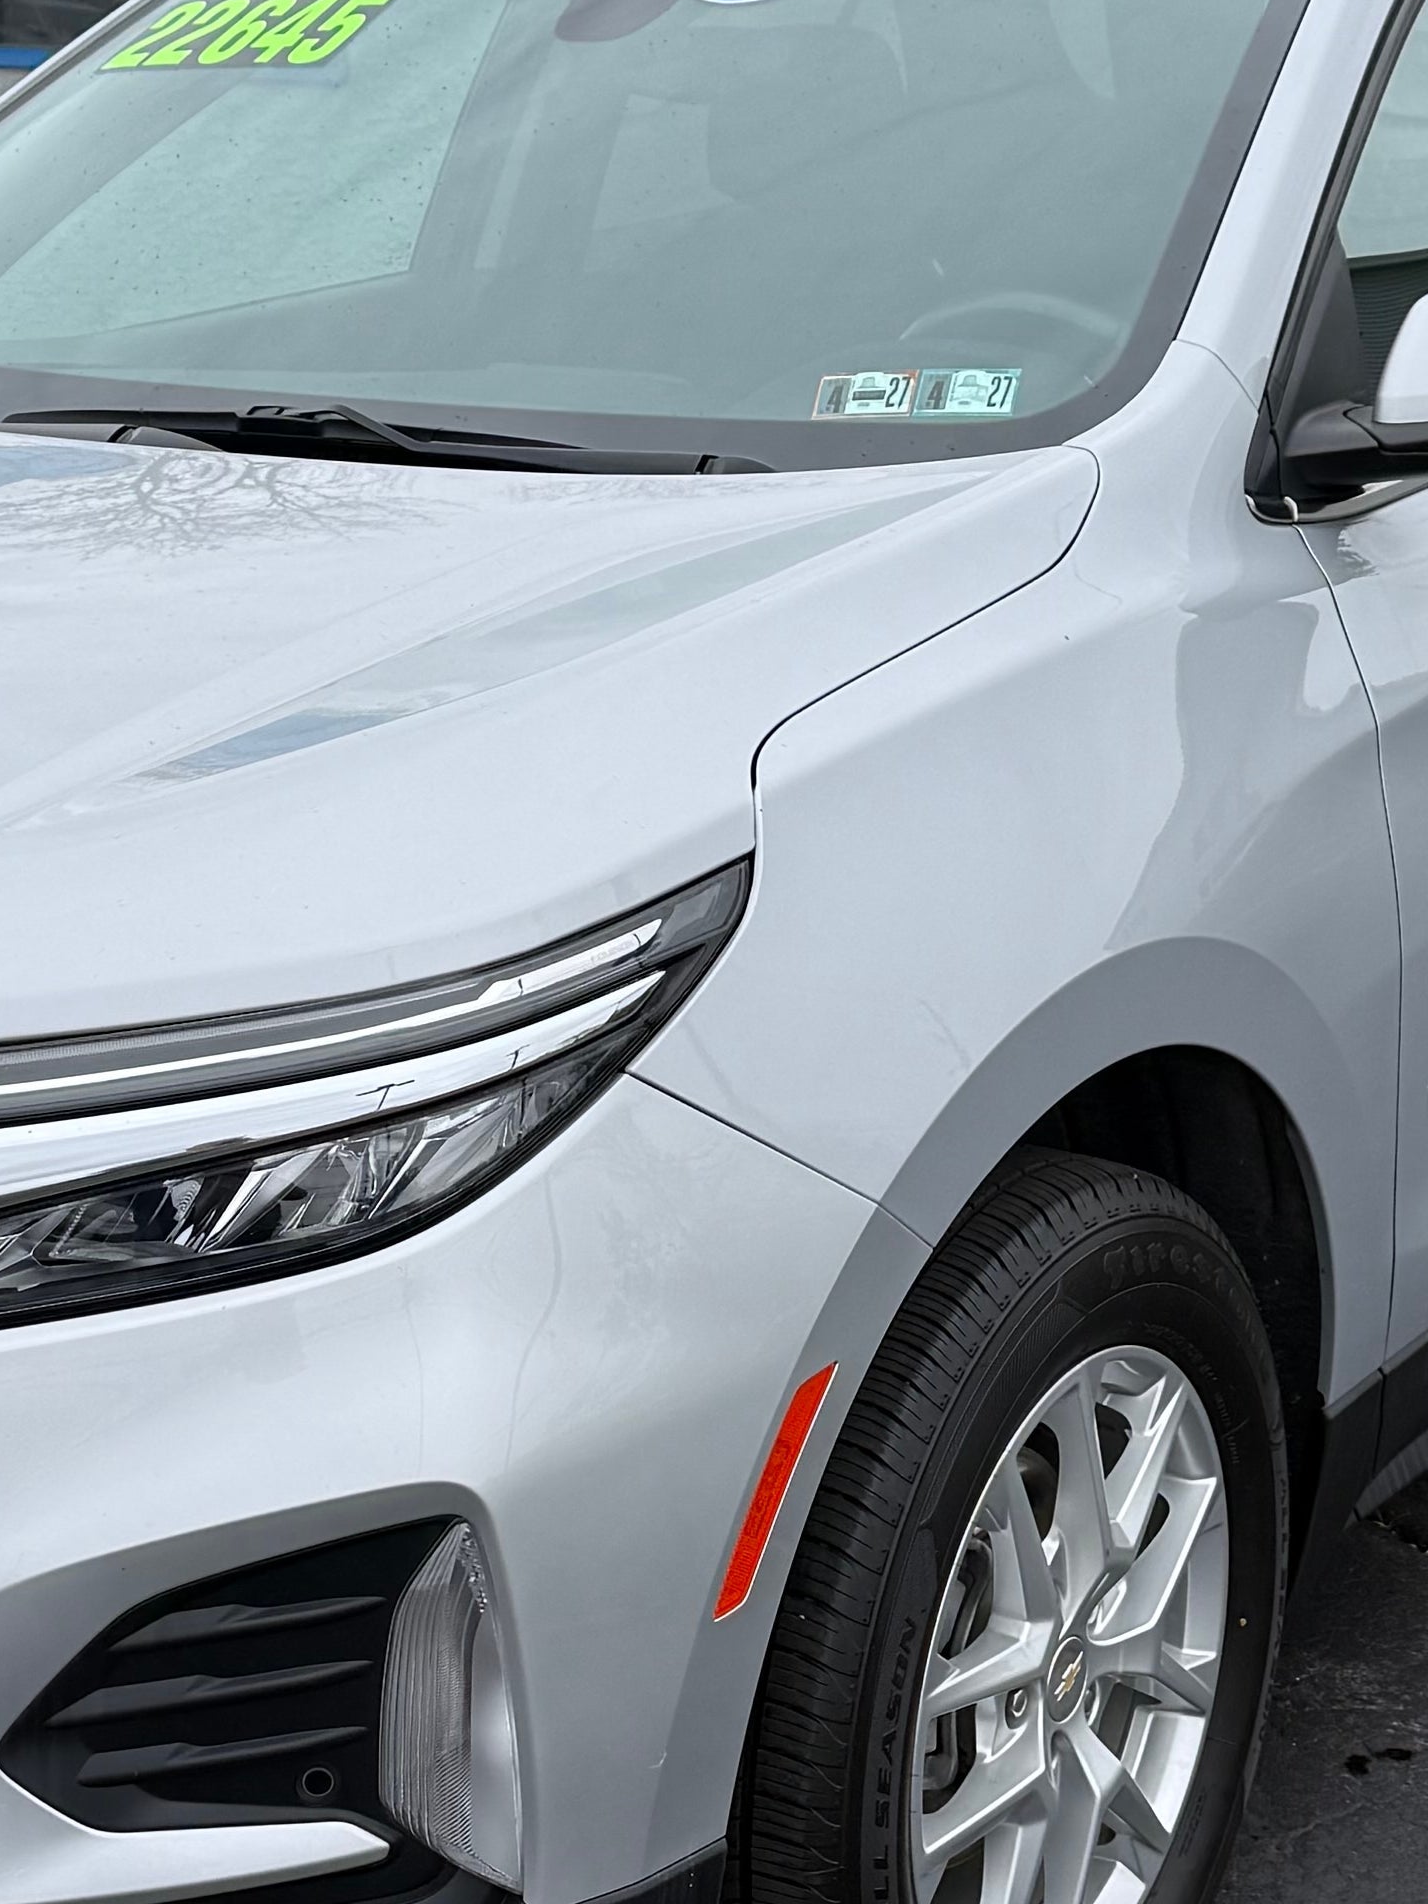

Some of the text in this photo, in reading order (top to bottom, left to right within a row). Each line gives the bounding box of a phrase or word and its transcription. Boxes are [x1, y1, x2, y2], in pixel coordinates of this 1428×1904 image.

[885, 376, 911, 408] 27
[925, 376, 1013, 409] 4 27
[874, 1616, 917, 1830] SEASON
